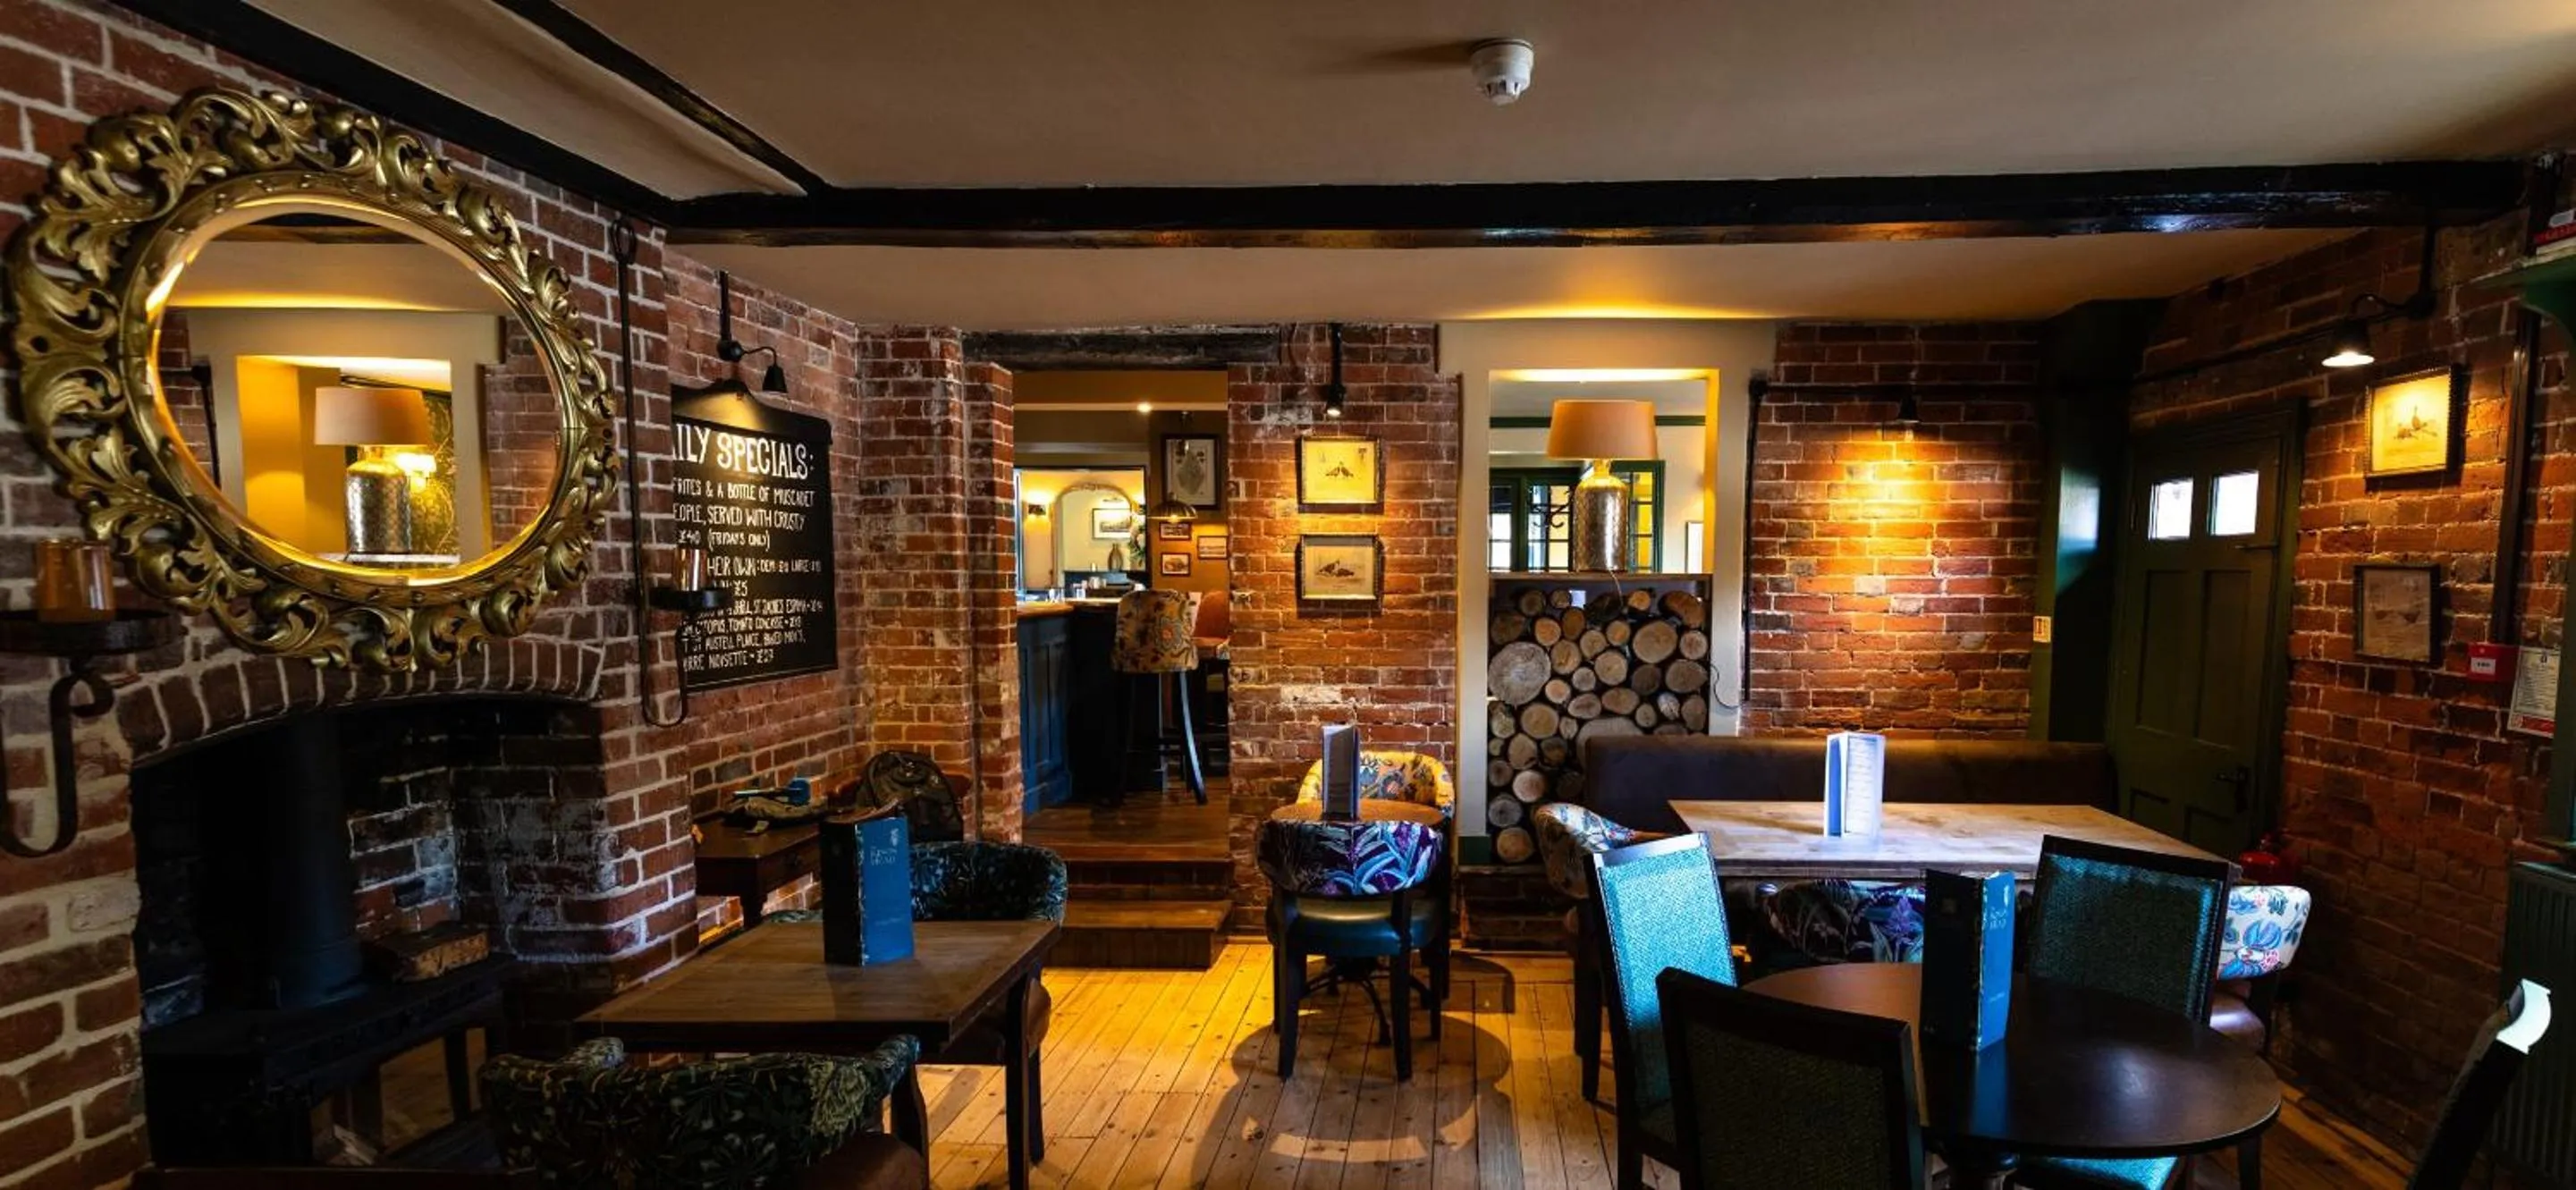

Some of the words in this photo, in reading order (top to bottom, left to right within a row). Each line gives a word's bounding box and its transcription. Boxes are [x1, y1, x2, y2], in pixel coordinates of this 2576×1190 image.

[672, 423, 711, 464] ILY
[717, 432, 815, 479] SPECIALS:
[727, 483, 756, 501] BOTTLE
[758, 485, 770, 502] OF
[707, 505, 743, 526] SERVED
[745, 508, 773, 528] WITH
